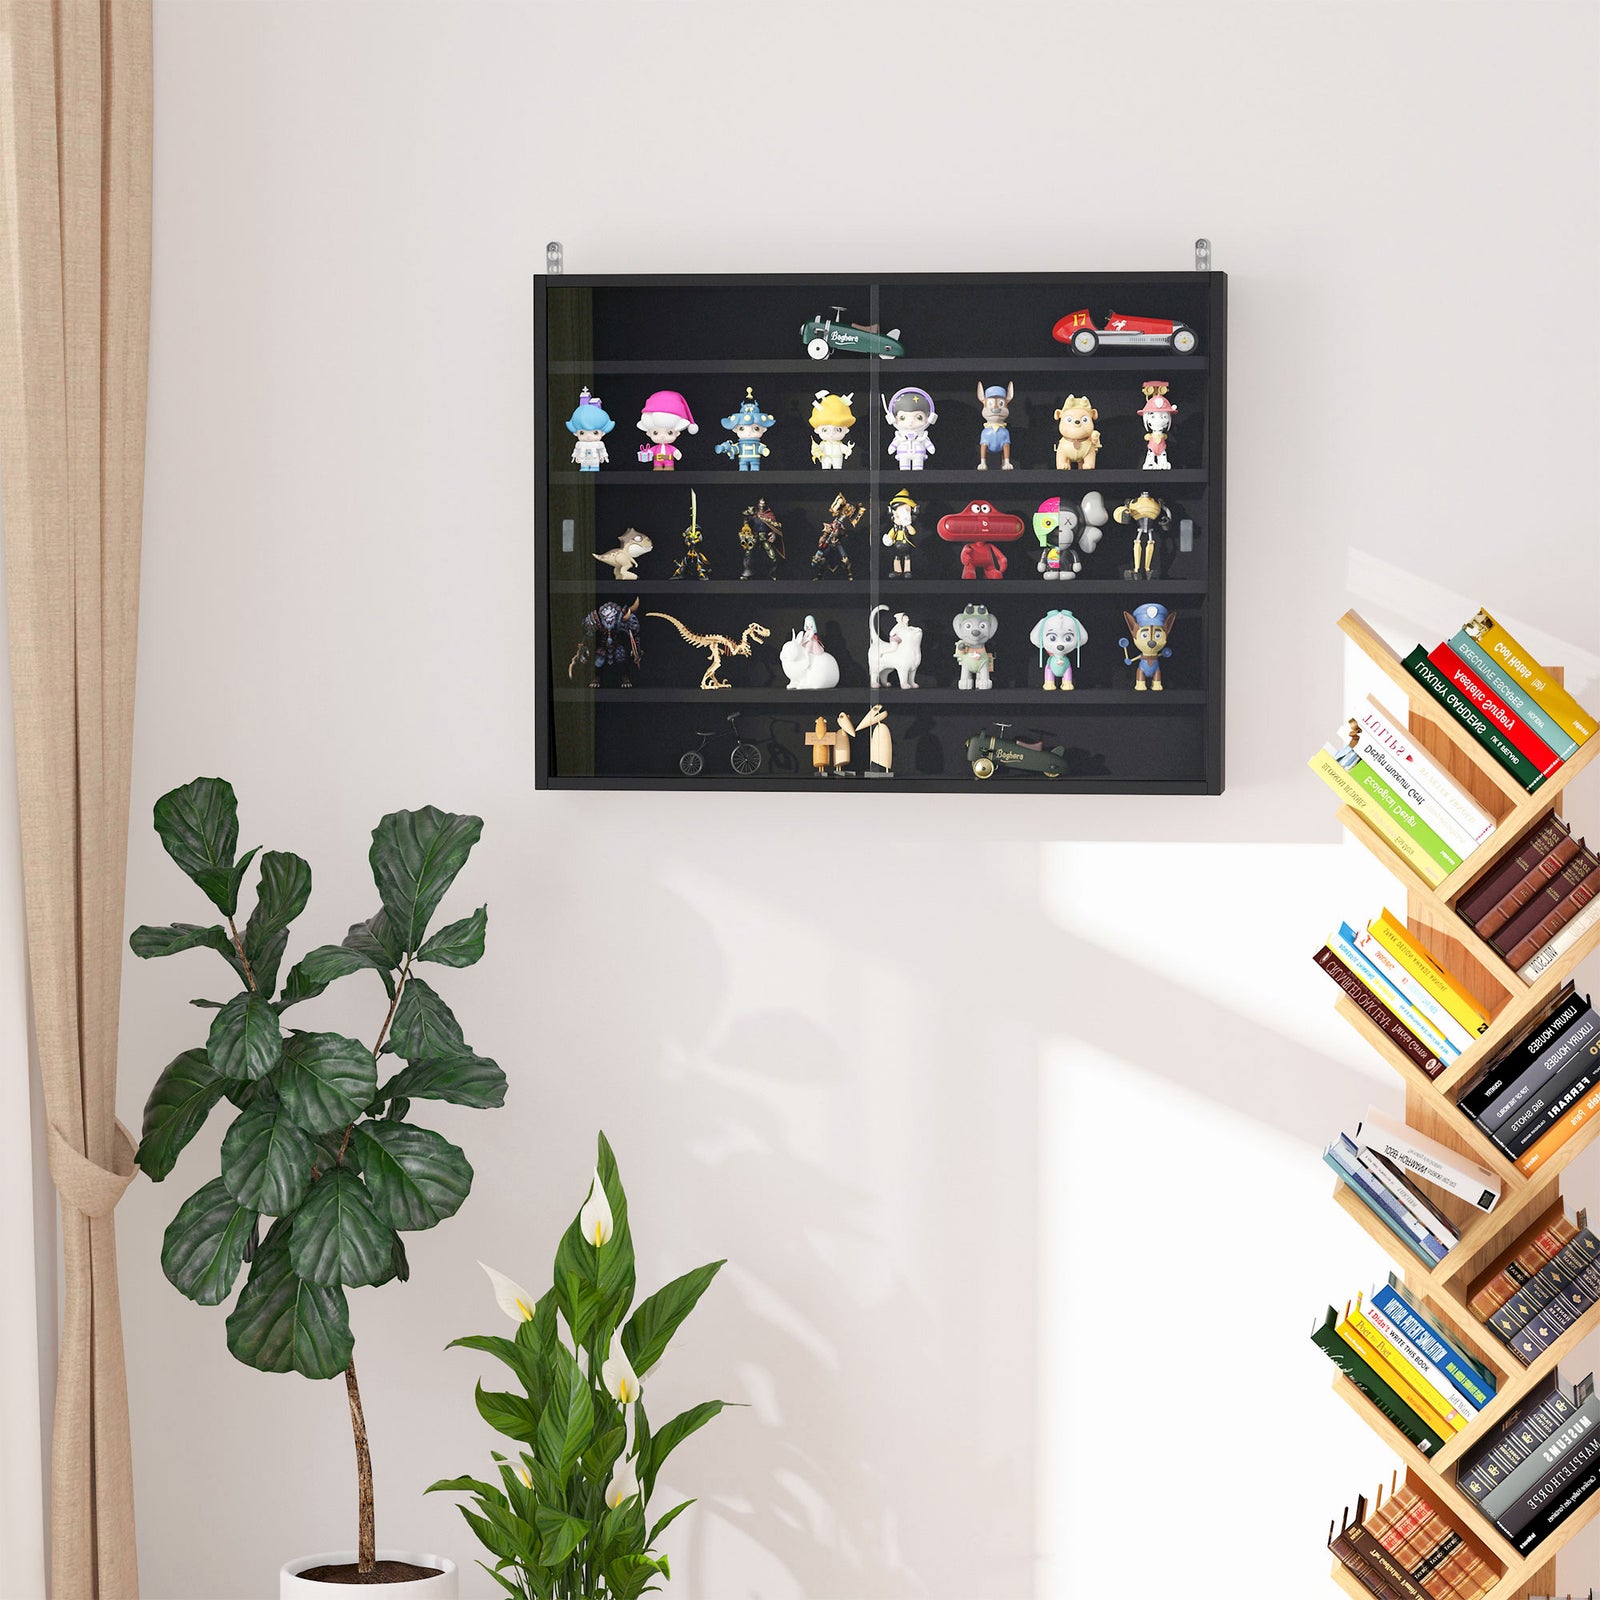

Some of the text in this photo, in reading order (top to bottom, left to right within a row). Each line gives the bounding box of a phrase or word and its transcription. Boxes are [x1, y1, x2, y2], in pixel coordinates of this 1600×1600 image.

[1072, 313, 1086, 327] 17
[1382, 1298, 1409, 1324] VIRTUAL
[1356, 1320, 1372, 1337] Poet
[1376, 1341, 1393, 1358] Poet
[1367, 1308, 1473, 1418] I Didn't WRITE THIS BOOK Jeff Watts
